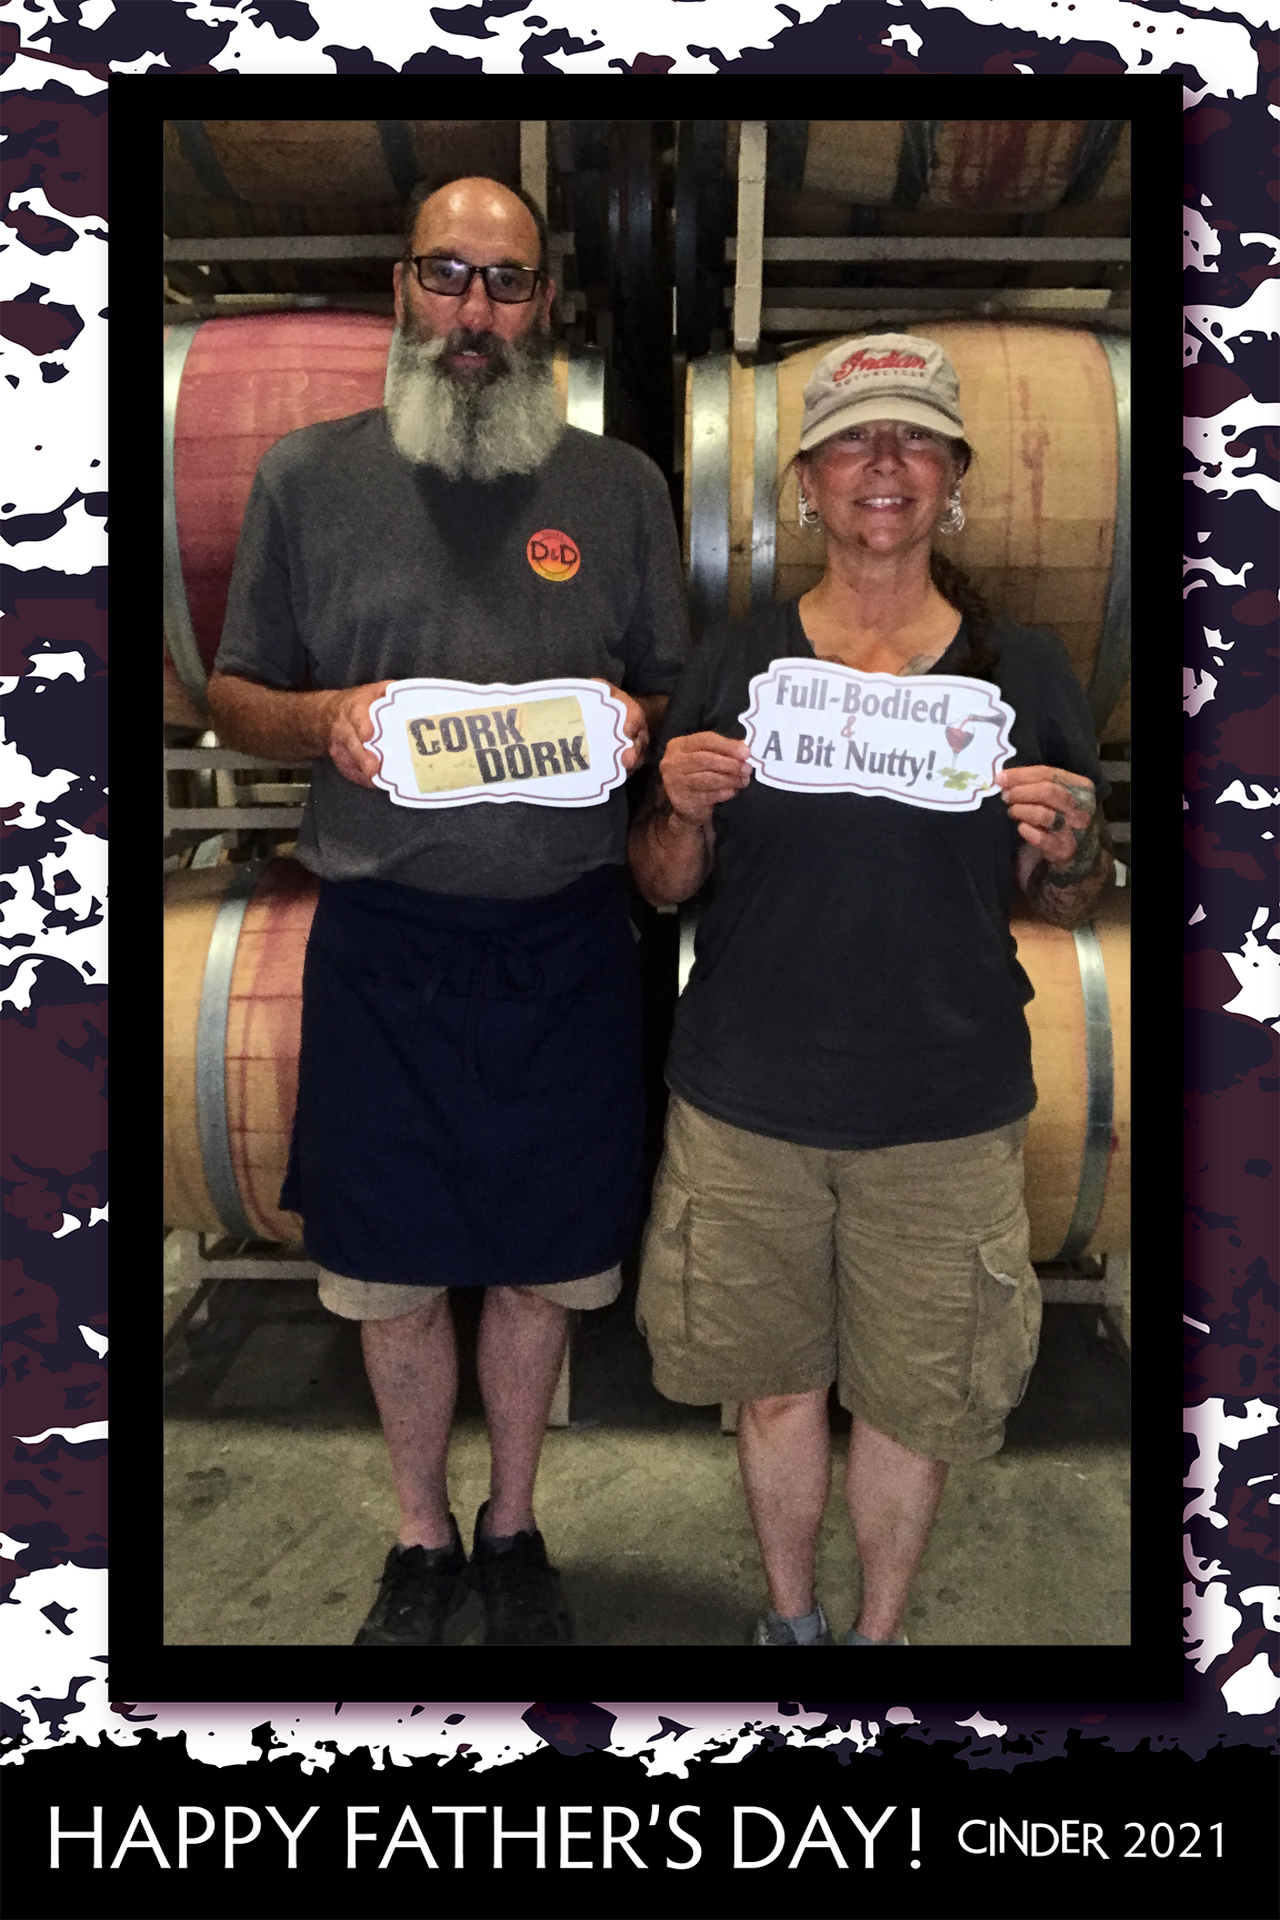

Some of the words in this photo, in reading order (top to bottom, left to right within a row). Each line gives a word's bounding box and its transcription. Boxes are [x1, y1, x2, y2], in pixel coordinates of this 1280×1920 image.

[833, 348, 926, 382] Indian
[775, 675, 951, 725] Full-Bodied
[410, 708, 525, 756] CORK
[840, 715, 857, 740] &
[475, 735, 590, 784] DORK
[762, 730, 784, 762] A
[795, 733, 836, 768] Bit
[844, 740, 937, 788] Nutty!
